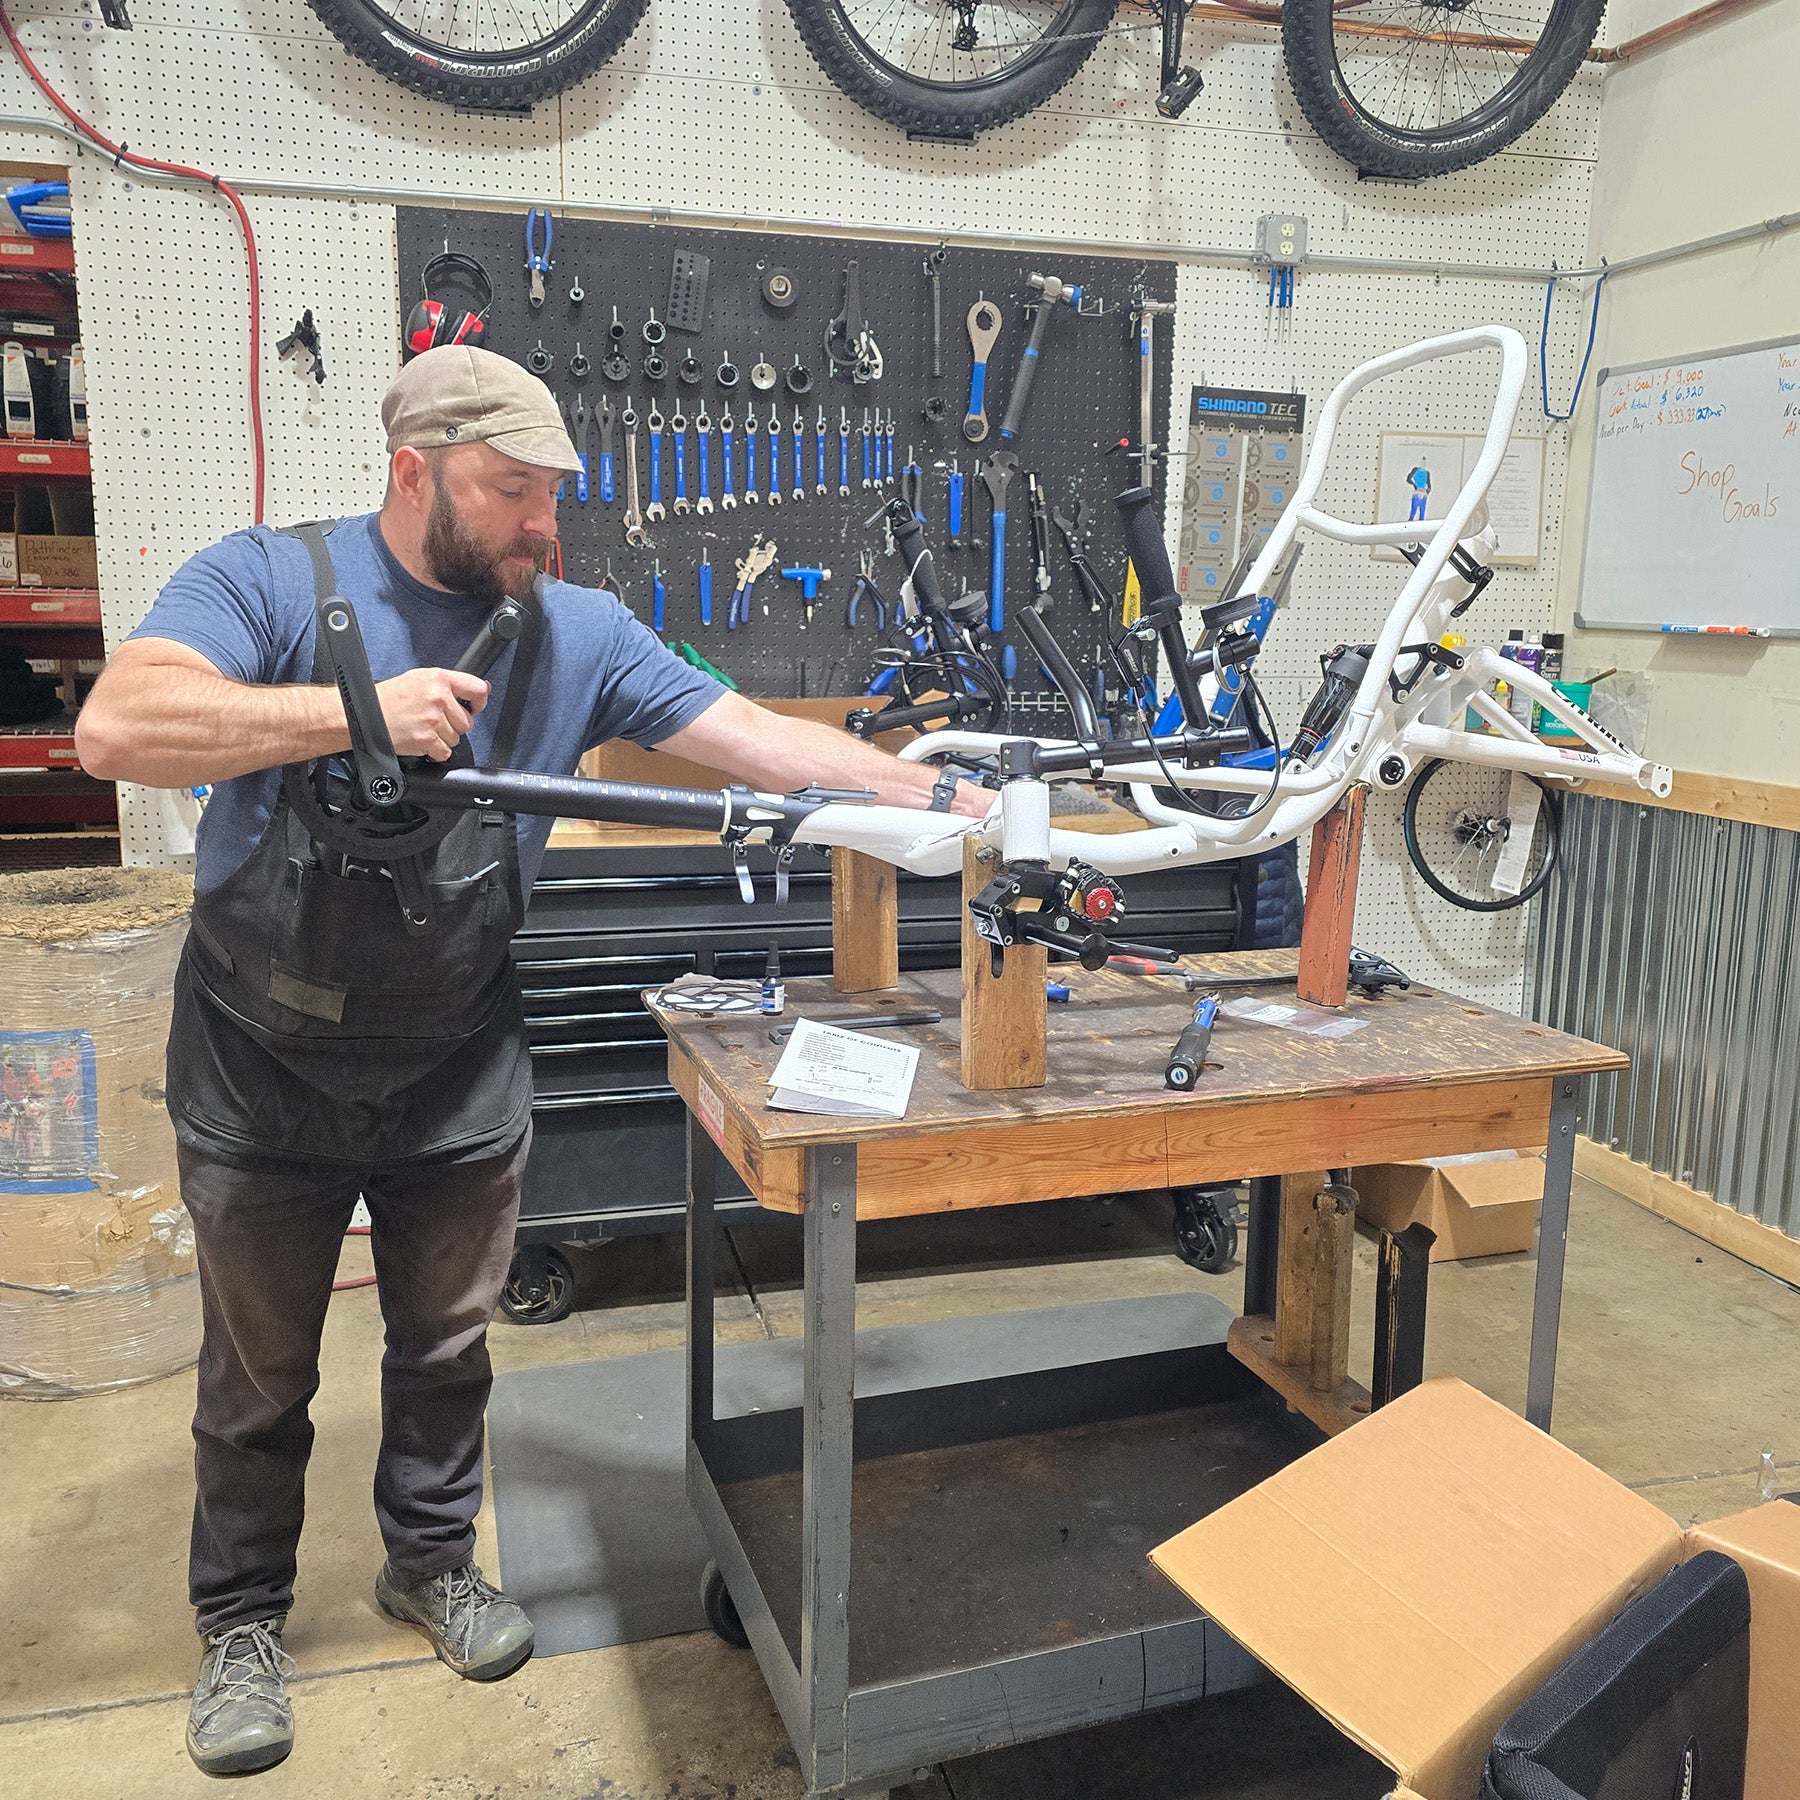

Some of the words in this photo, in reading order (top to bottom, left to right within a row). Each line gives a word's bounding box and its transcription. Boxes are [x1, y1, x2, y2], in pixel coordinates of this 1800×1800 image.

[438, 57, 542, 78] CONTROL
[1198, 397, 1267, 414] SHIMANO
[1676, 450, 1736, 500] Shop
[1722, 482, 1781, 524] Goals
[1578, 753, 1601, 765] USA
